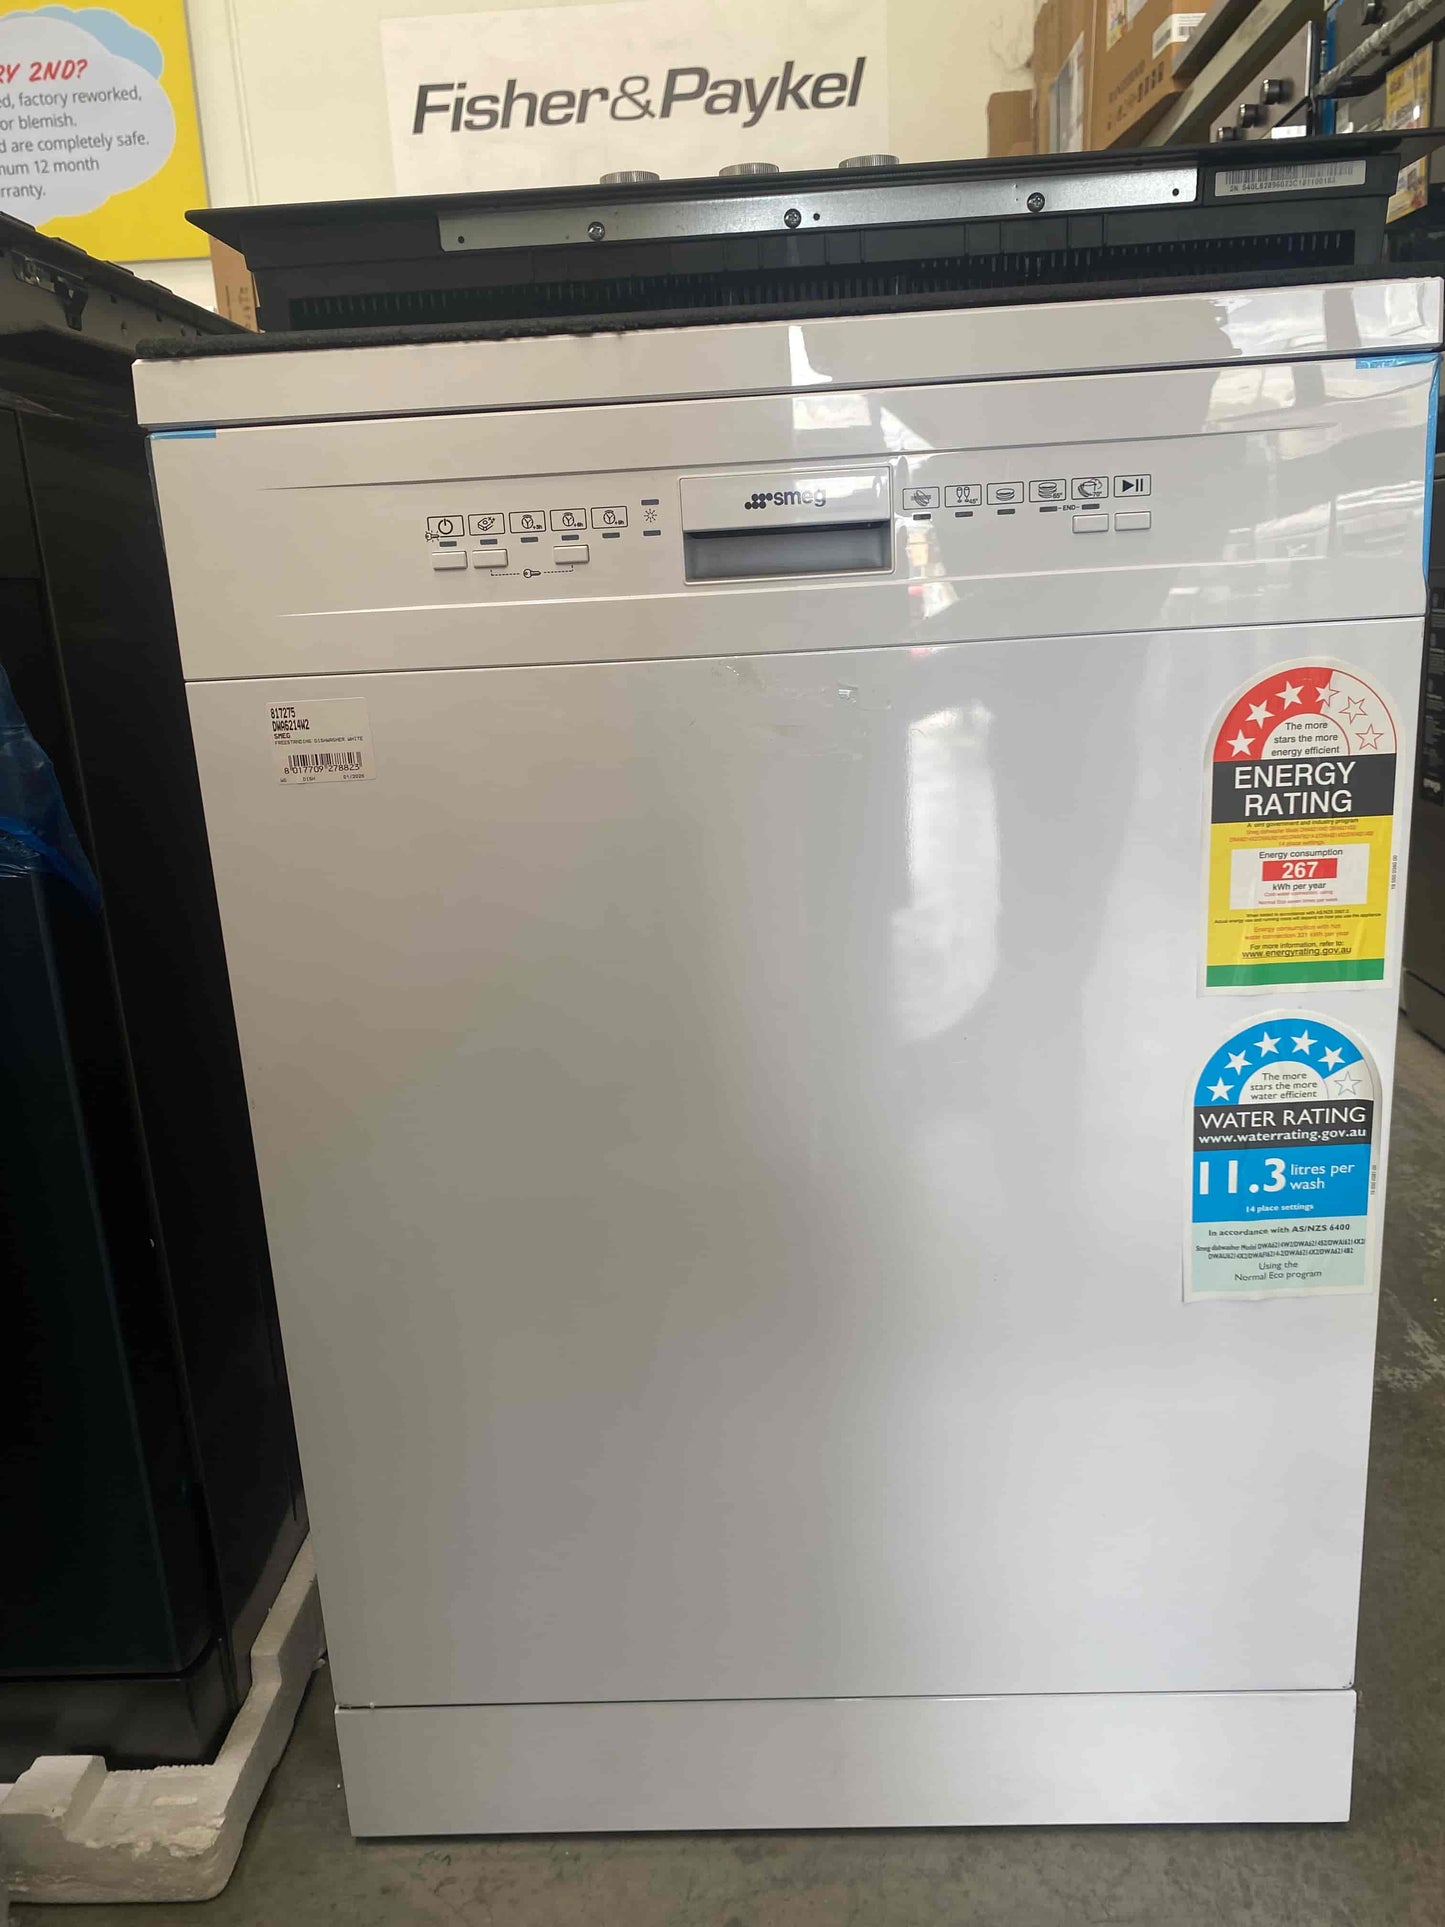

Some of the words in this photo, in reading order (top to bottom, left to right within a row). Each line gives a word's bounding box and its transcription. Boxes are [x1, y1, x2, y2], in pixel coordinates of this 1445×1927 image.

[29, 58, 88, 82] 2ND?
[0, 93, 15, 109] d,
[18, 91, 68, 109] factory
[72, 85, 141, 103] reworked,
[18, 112, 77, 130] blemish.
[11, 141, 34, 153] are
[37, 132, 113, 153] completely
[116, 130, 149, 148] safe.
[34, 160, 49, 174] 12
[53, 156, 100, 172] month
[773, 488, 826, 508] smeg
[270, 707, 296, 720] 817275
[1286, 722, 1302, 730] The
[1305, 722, 1328, 730] more
[1274, 735, 1296, 744] stars
[1299, 734, 1312, 742] the
[1315, 734, 1338, 742] more
[1271, 748, 1302, 758] energy
[1304, 746, 1340, 755] efficient
[1234, 761, 1356, 790] ENERGY
[1244, 790, 1352, 817] RATING
[1259, 851, 1288, 860] Energy
[1290, 848, 1344, 858] consumption
[1282, 861, 1318, 879] 267
[1272, 882, 1290, 890] kWh
[1308, 882, 1326, 890] year
[1262, 1072, 1280, 1081] The
[1250, 1083, 1273, 1091] stars
[1250, 1092, 1276, 1100] water
[1280, 1090, 1318, 1099] efficient
[1200, 1111, 1276, 1129] WATER
[1283, 1107, 1366, 1126] RATING
[1199, 1128, 1366, 1144] www.waterrating.gov.au
[1200, 1158, 1286, 1195] 11.3
[1290, 1164, 1326, 1176] litres
[1330, 1164, 1355, 1178] per
[1290, 1178, 1325, 1190] wash
[1257, 1204, 1280, 1214] place
[1282, 1204, 1314, 1212] settings
[1258, 1262, 1282, 1270] Using
[1234, 1273, 1266, 1281] Normal
[1268, 1272, 1284, 1280] Eco
[1286, 1271, 1322, 1280] program
